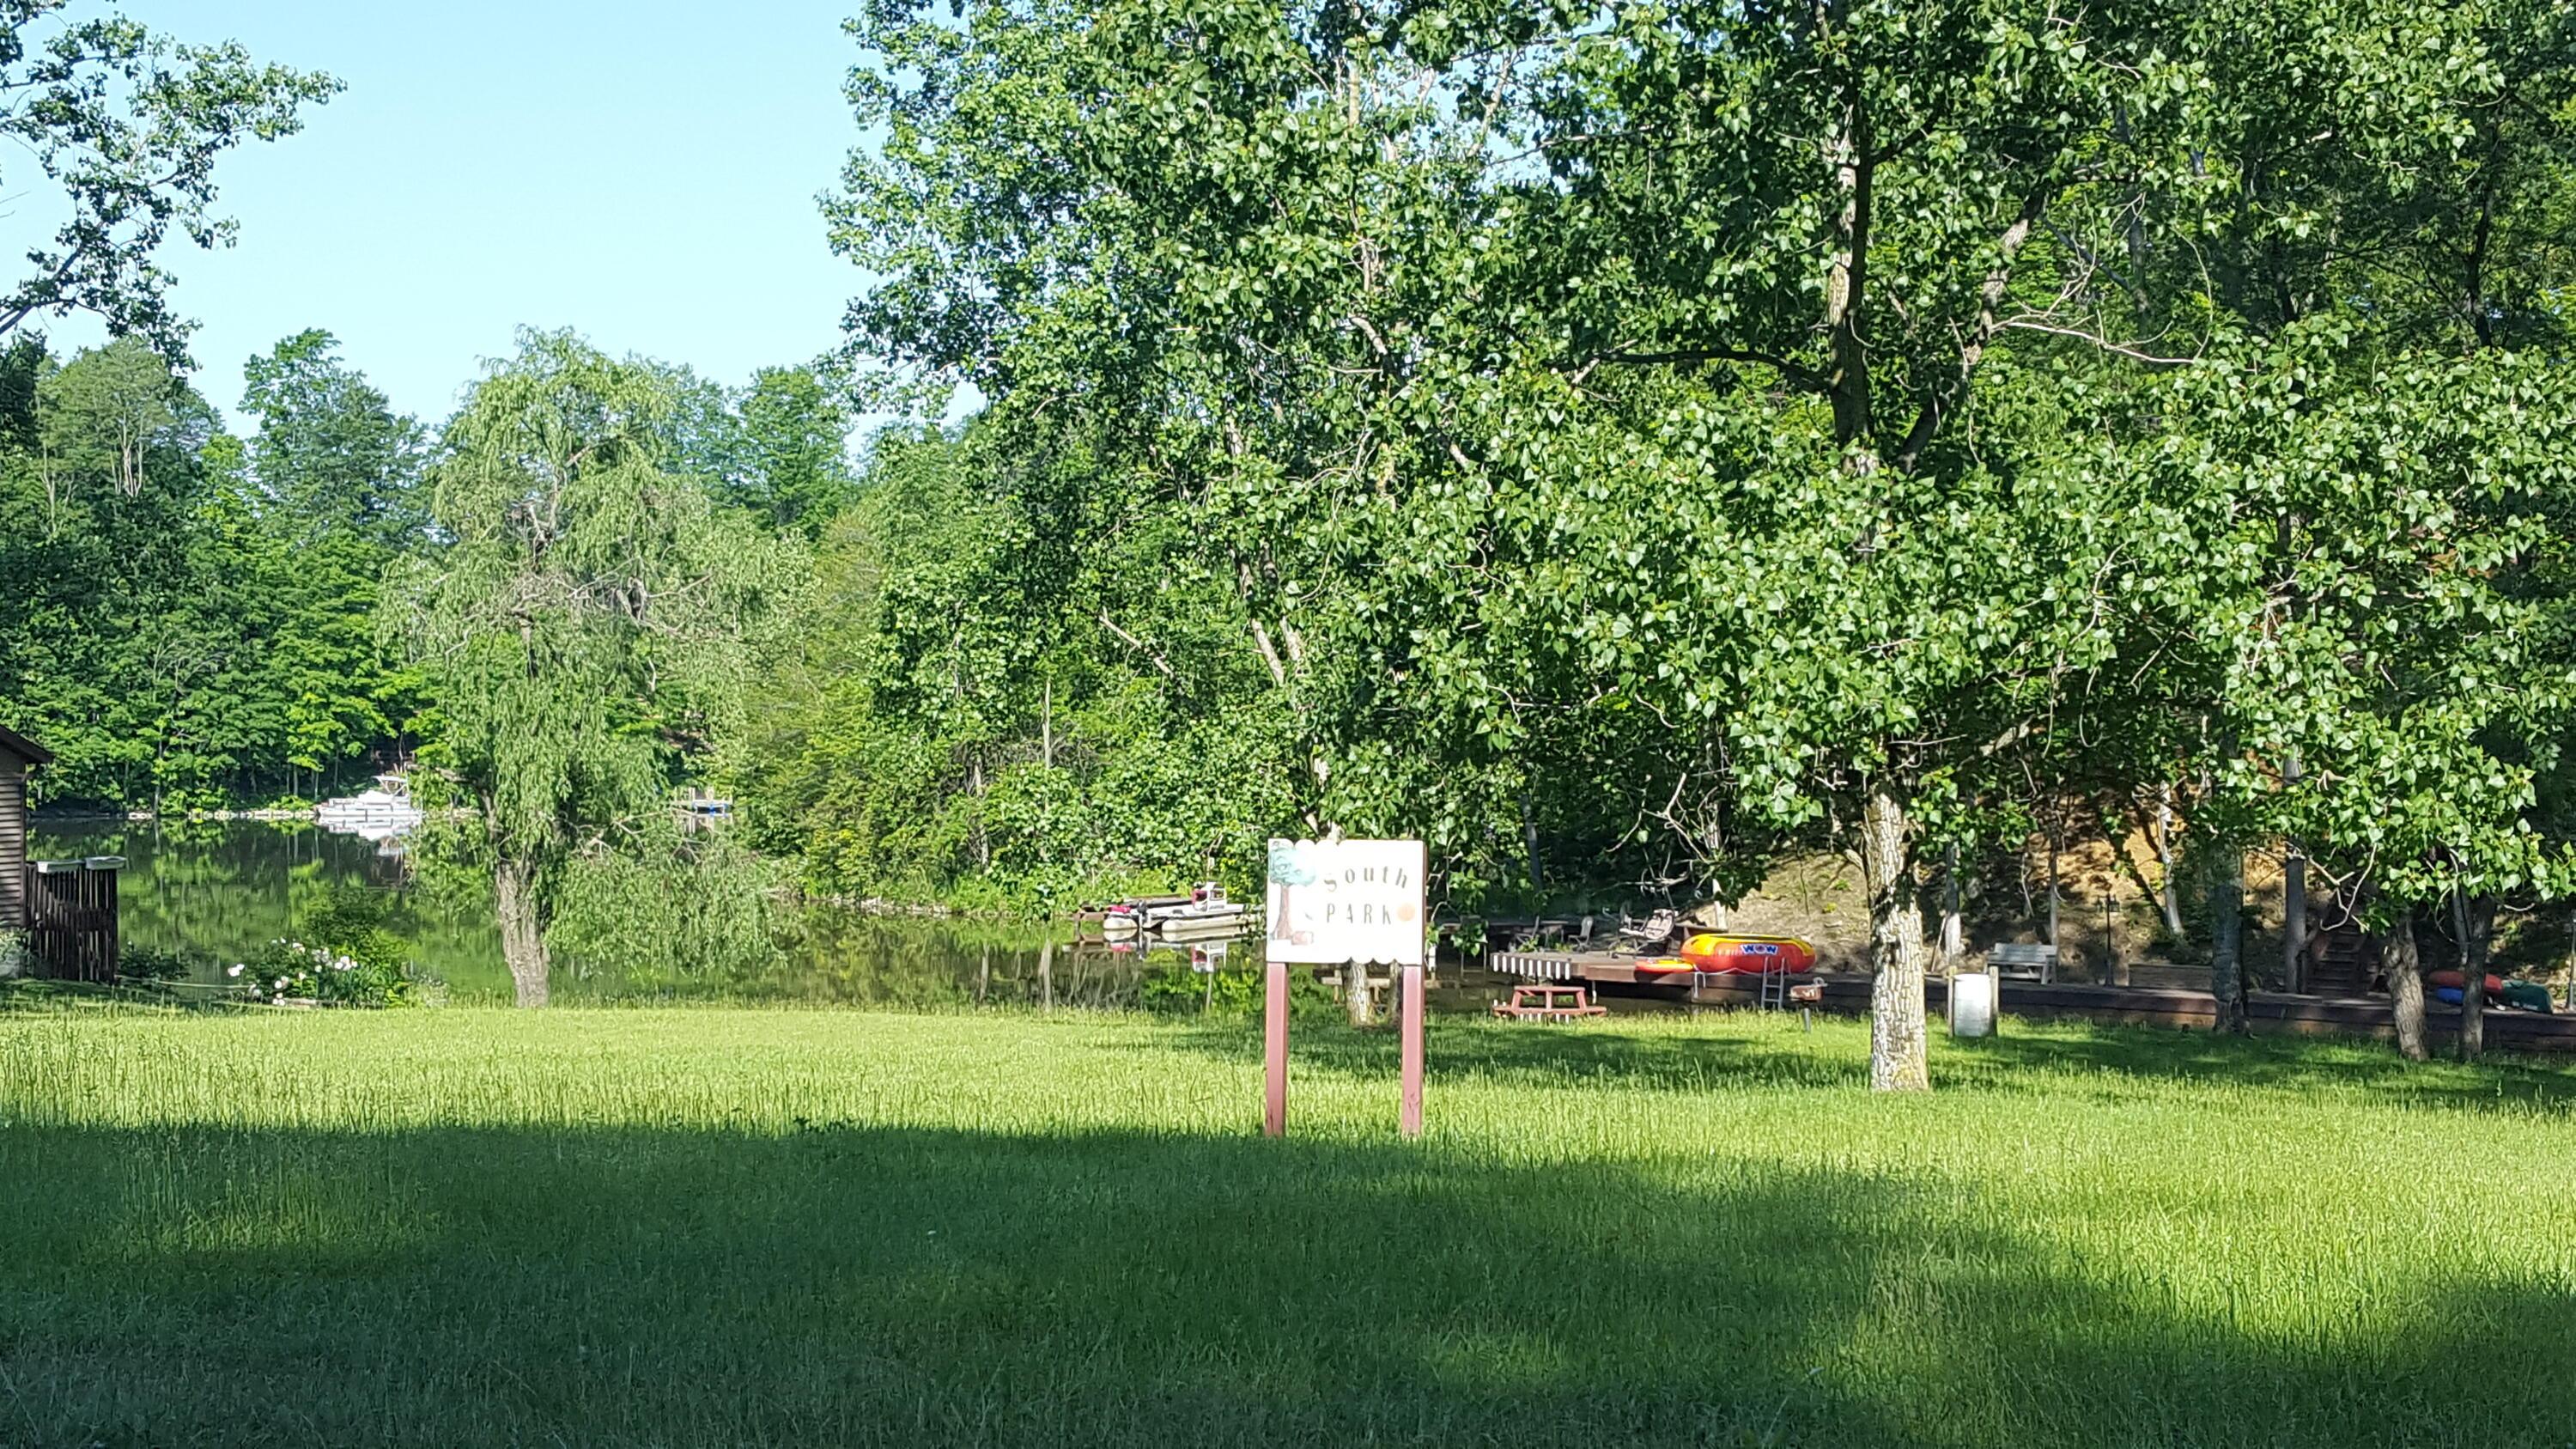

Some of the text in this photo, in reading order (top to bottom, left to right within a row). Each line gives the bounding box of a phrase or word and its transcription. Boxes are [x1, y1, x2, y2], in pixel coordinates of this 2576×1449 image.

[1323, 865, 1408, 892] South
[1326, 902, 1392, 925] PARK
[1741, 944, 1778, 954] WOW
